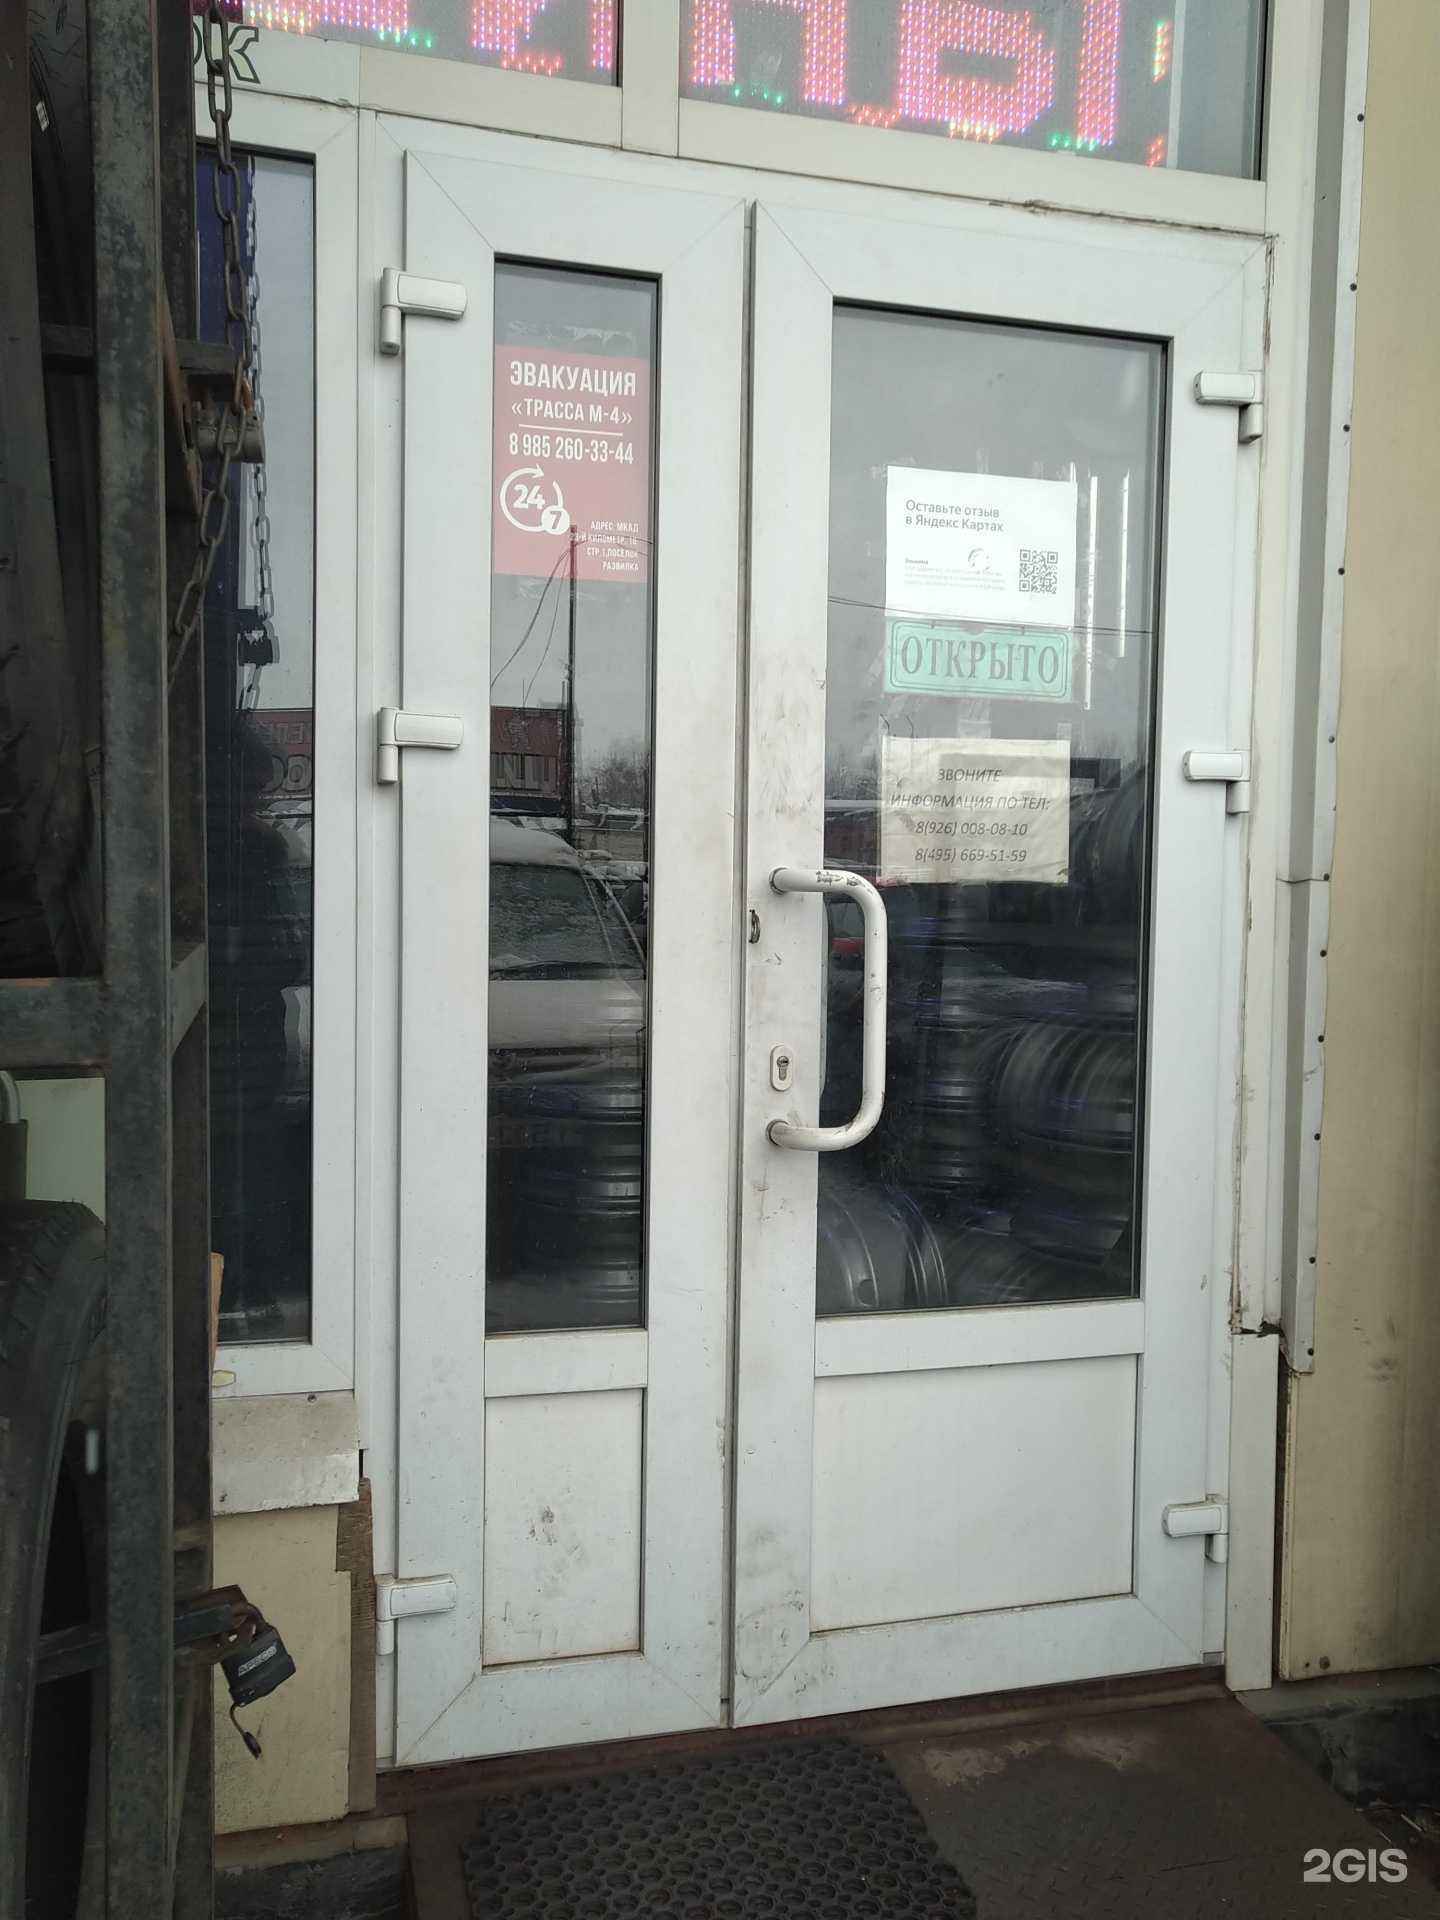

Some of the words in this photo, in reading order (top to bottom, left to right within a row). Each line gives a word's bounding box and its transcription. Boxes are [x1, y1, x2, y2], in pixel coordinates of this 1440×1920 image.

[510, 360, 637, 397] ЭВАКУАЦИЯ
[511, 398, 585, 422] «ТРАССА
[588, 403, 633, 425] М-4»
[509, 432, 518, 455] 8
[522, 433, 551, 458] 985
[555, 436, 635, 464] 260-33-44
[513, 484, 546, 510] 24
[905, 499, 962, 516] Оставьте
[964, 506, 1000, 519] отзыв
[550, 510, 562, 530] 7
[905, 516, 912, 525] в
[915, 514, 960, 529] Яндекс
[962, 518, 1004, 532] Картах
[901, 635, 1060, 684] ОТКРЫТО
[937, 768, 1003, 783] ЗВОНИТЕ
[890, 793, 994, 811] ИНФОРМАЦИЯ
[997, 796, 1017, 809] ПО
[915, 821, 958, 837] 8(926)
[960, 822, 1029, 837] 008-08-10
[914, 847, 957, 863] 8(495)
[960, 848, 1027, 863] 669-51-59
